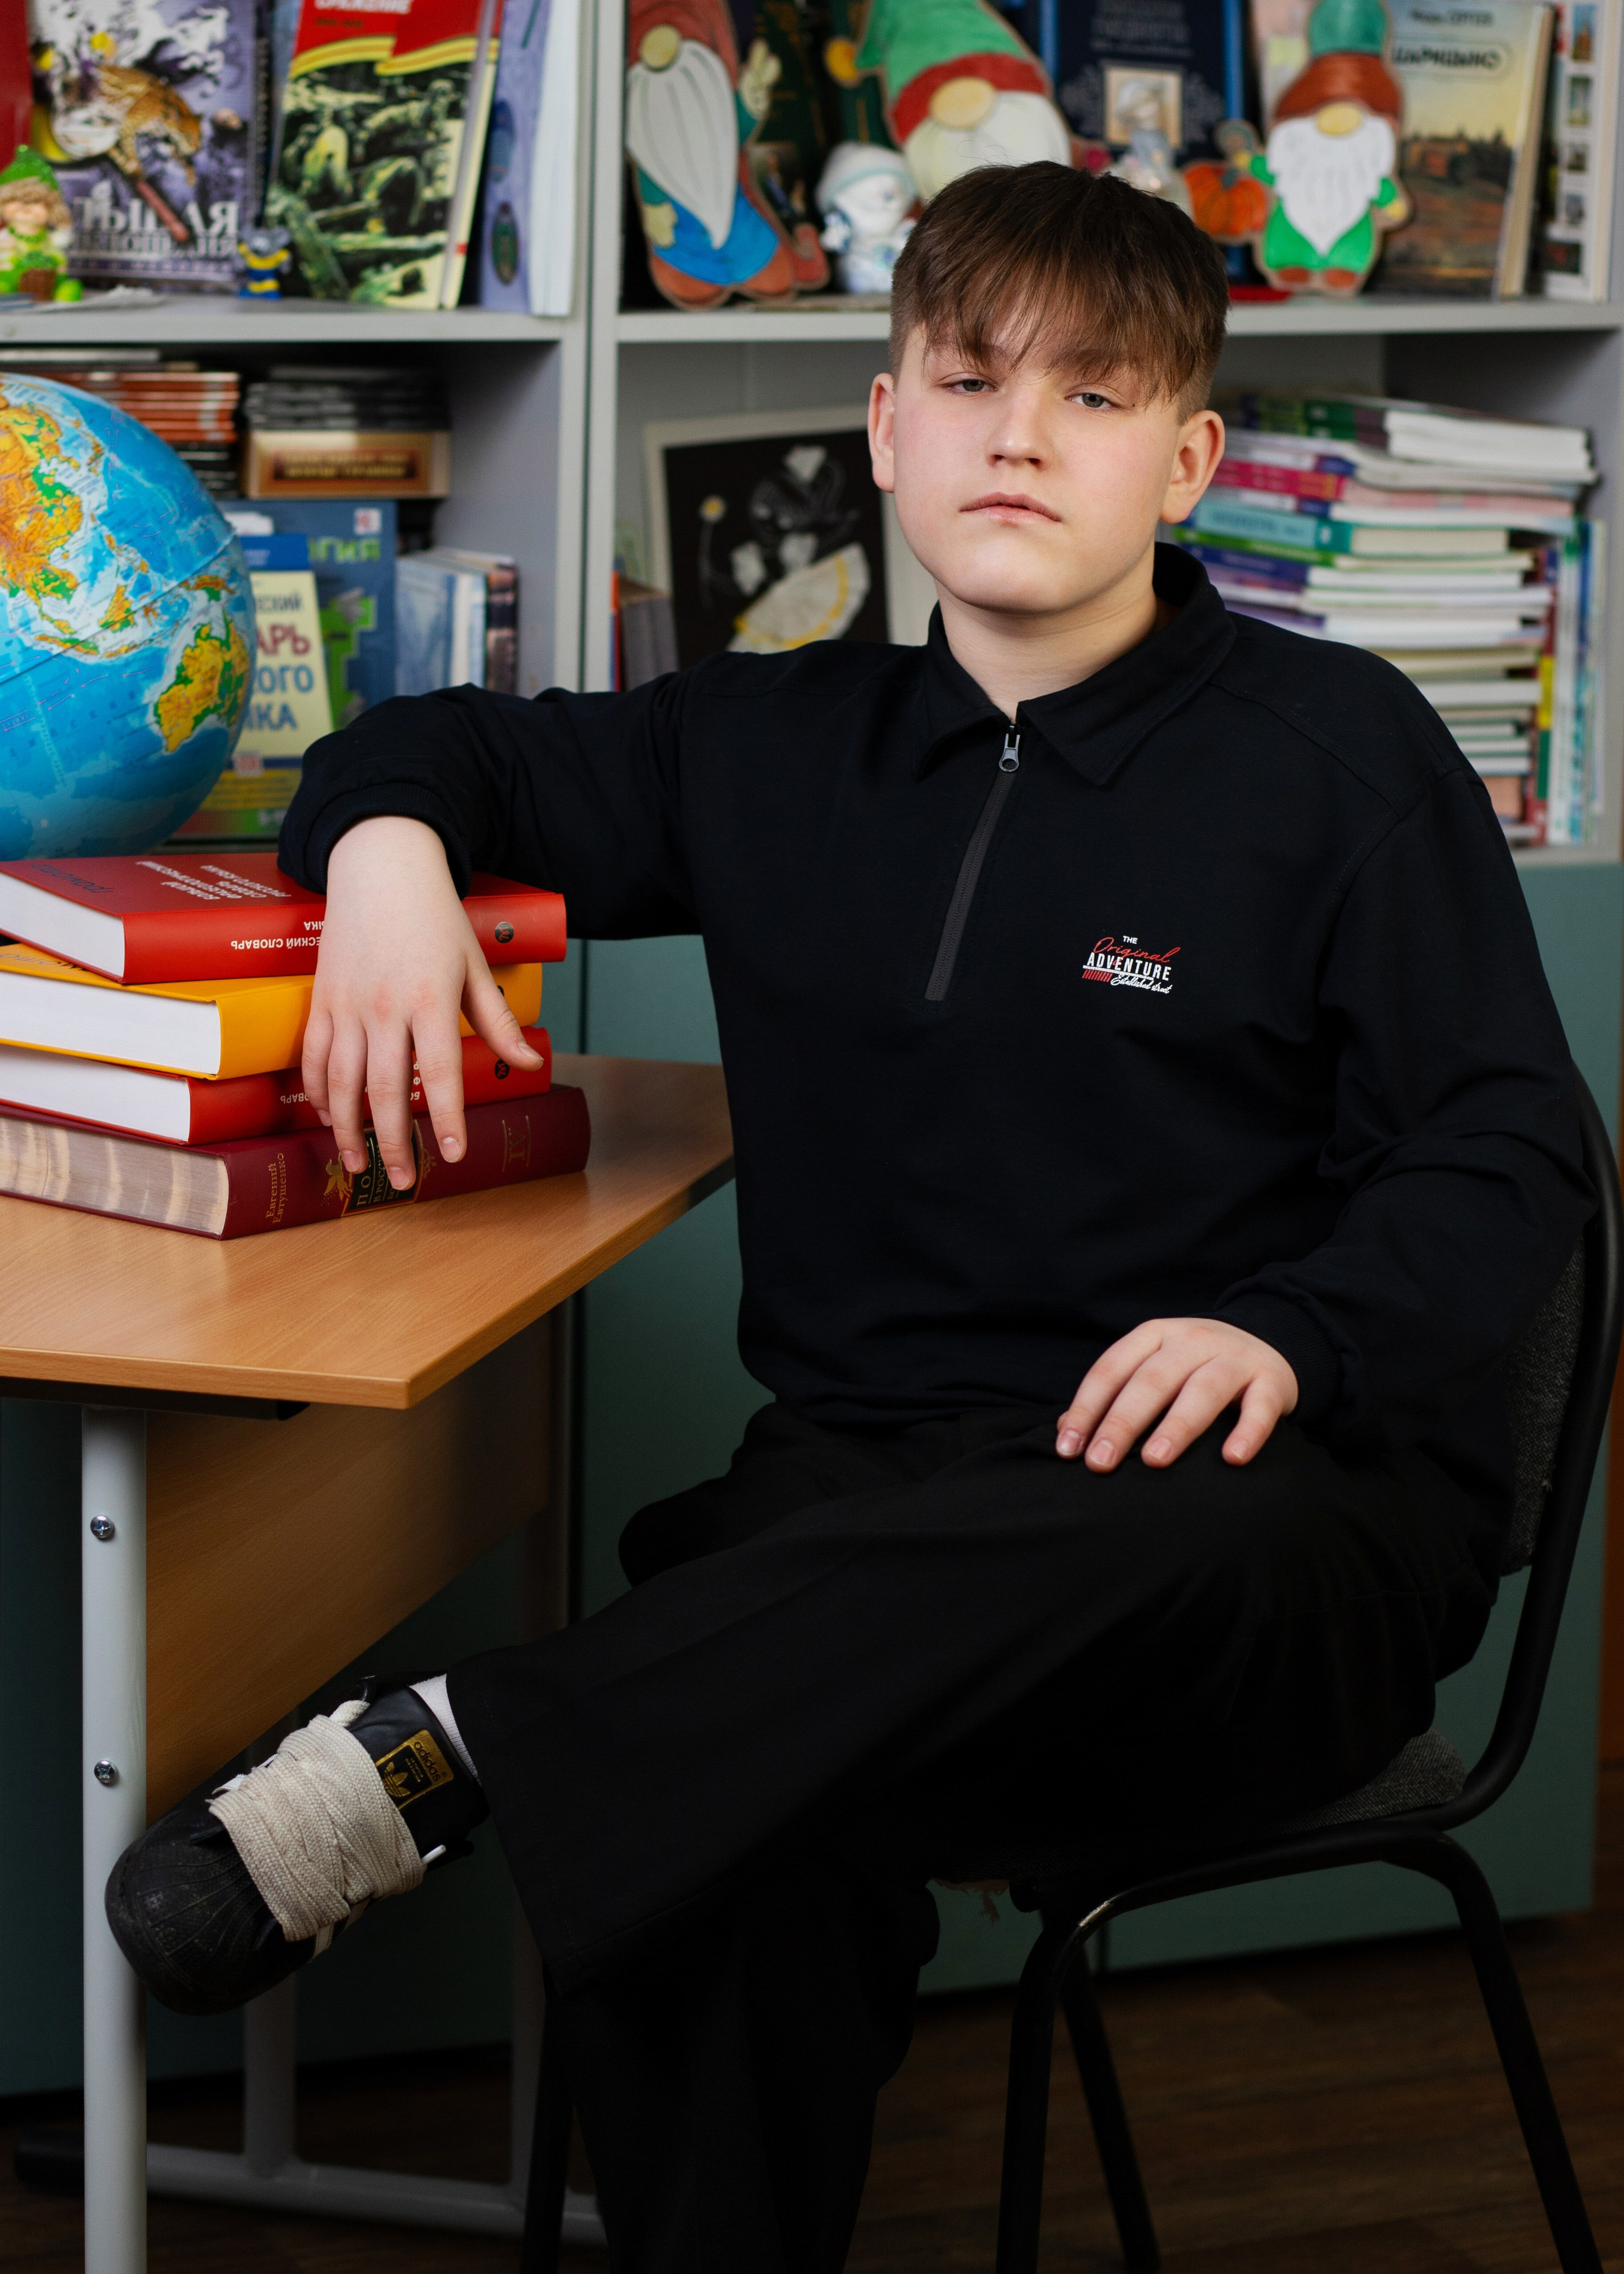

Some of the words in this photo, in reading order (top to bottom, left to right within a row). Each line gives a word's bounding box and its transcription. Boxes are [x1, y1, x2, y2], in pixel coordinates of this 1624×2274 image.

[255, 664, 314, 694] ОГО
[303, 921, 324, 931] ЫКА
[230, 939, 284, 950] СЛОВАРЬ
[286, 936, 321, 949] ЕСКИЙ
[1122, 935, 1138, 944] THE
[1092, 936, 1181, 965] Original
[1086, 951, 1172, 981] ADVENTURE
[280, 1092, 308, 1104] ОВАРЬ
[265, 1162, 278, 1219] Евгений
[272, 1153, 288, 1224] Евтушенко
[372, 1194, 383, 1203] В
[414, 1741, 442, 1782] adidas
